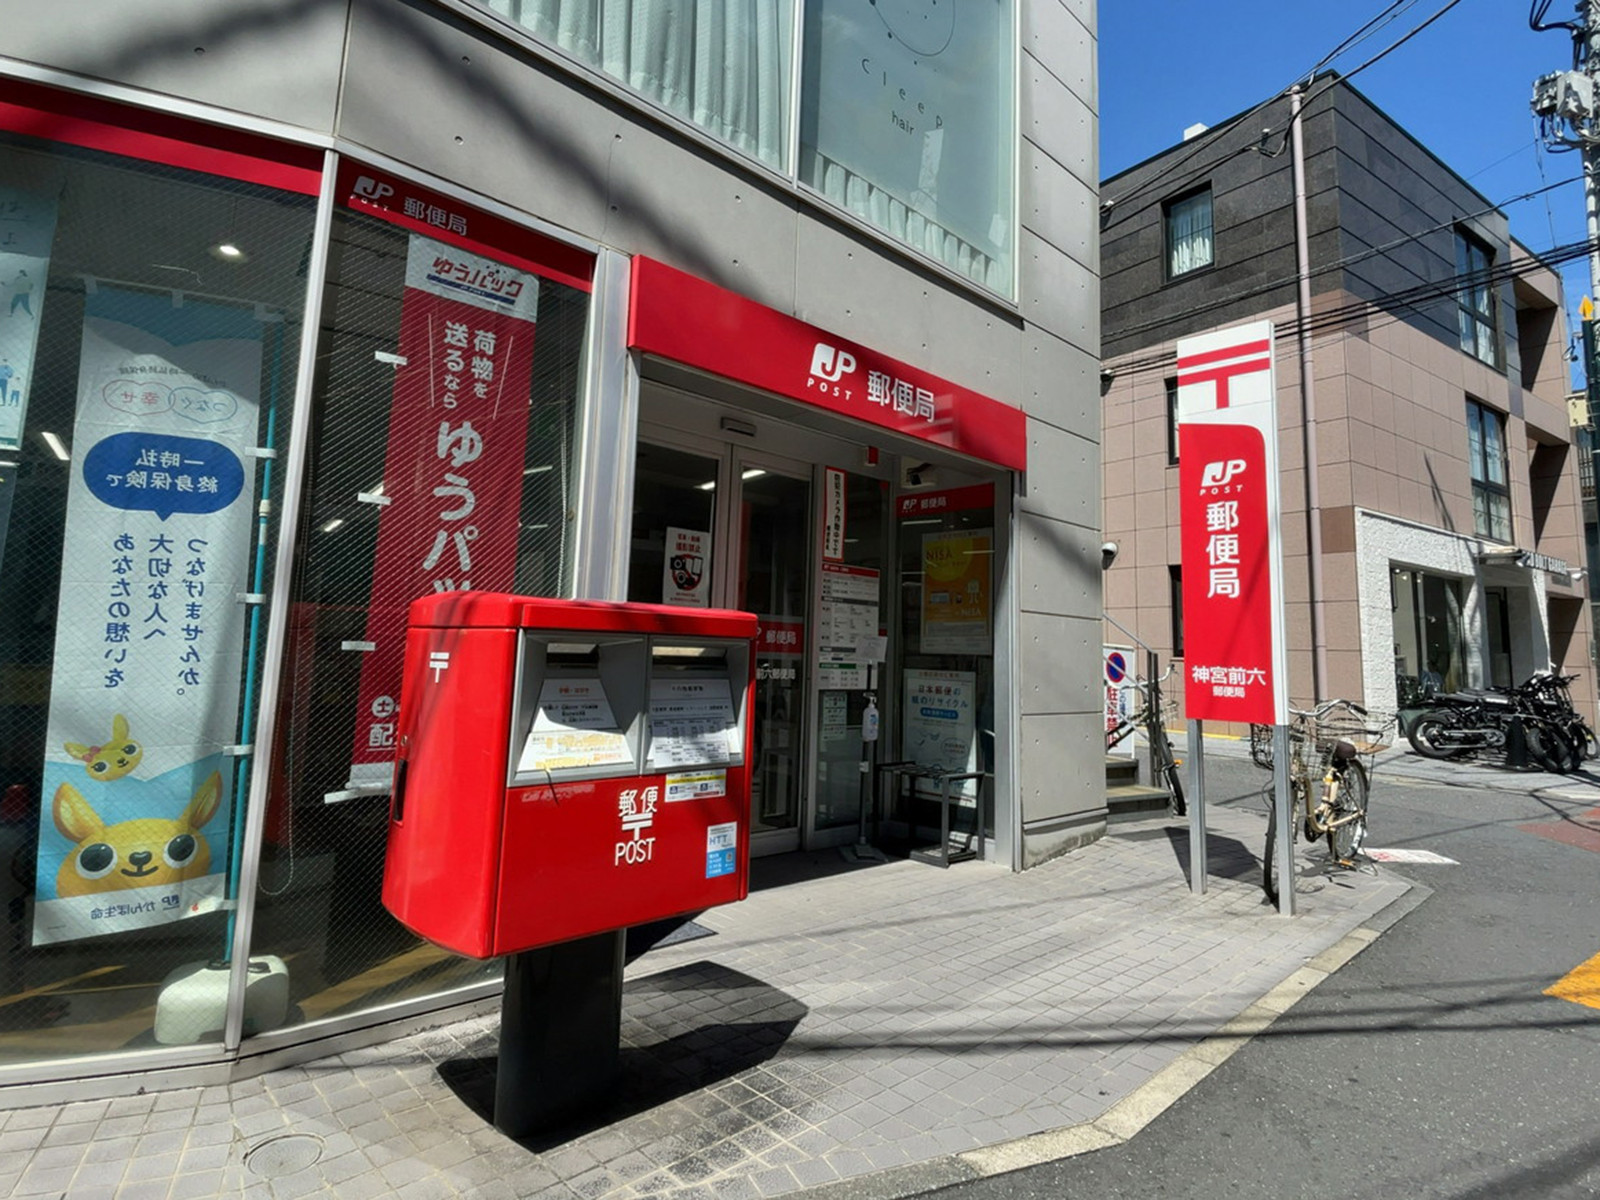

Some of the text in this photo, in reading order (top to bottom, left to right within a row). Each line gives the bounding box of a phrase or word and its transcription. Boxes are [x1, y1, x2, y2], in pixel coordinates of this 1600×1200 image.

[891, 111, 915, 135] hair
[350, 193, 389, 212] POST
[403, 196, 468, 236] 郵便局
[432, 256, 524, 297] ゆうパック
[443, 321, 469, 409] 送るなら
[470, 328, 497, 399] 荷物を
[806, 378, 852, 401] POST
[866, 370, 936, 423] 郵便局
[921, 495, 947, 510] 郵便局
[1199, 484, 1245, 497] POST
[1205, 500, 1241, 599] 郵便局
[765, 629, 797, 645] 郵便局
[1191, 664, 1266, 686] 神宮前六
[1213, 685, 1246, 699] 郵便局
[368, 722, 398, 748] 配
[618, 786, 659, 817] 郵便
[614, 837, 656, 866] POST
[709, 834, 728, 846] HTT
